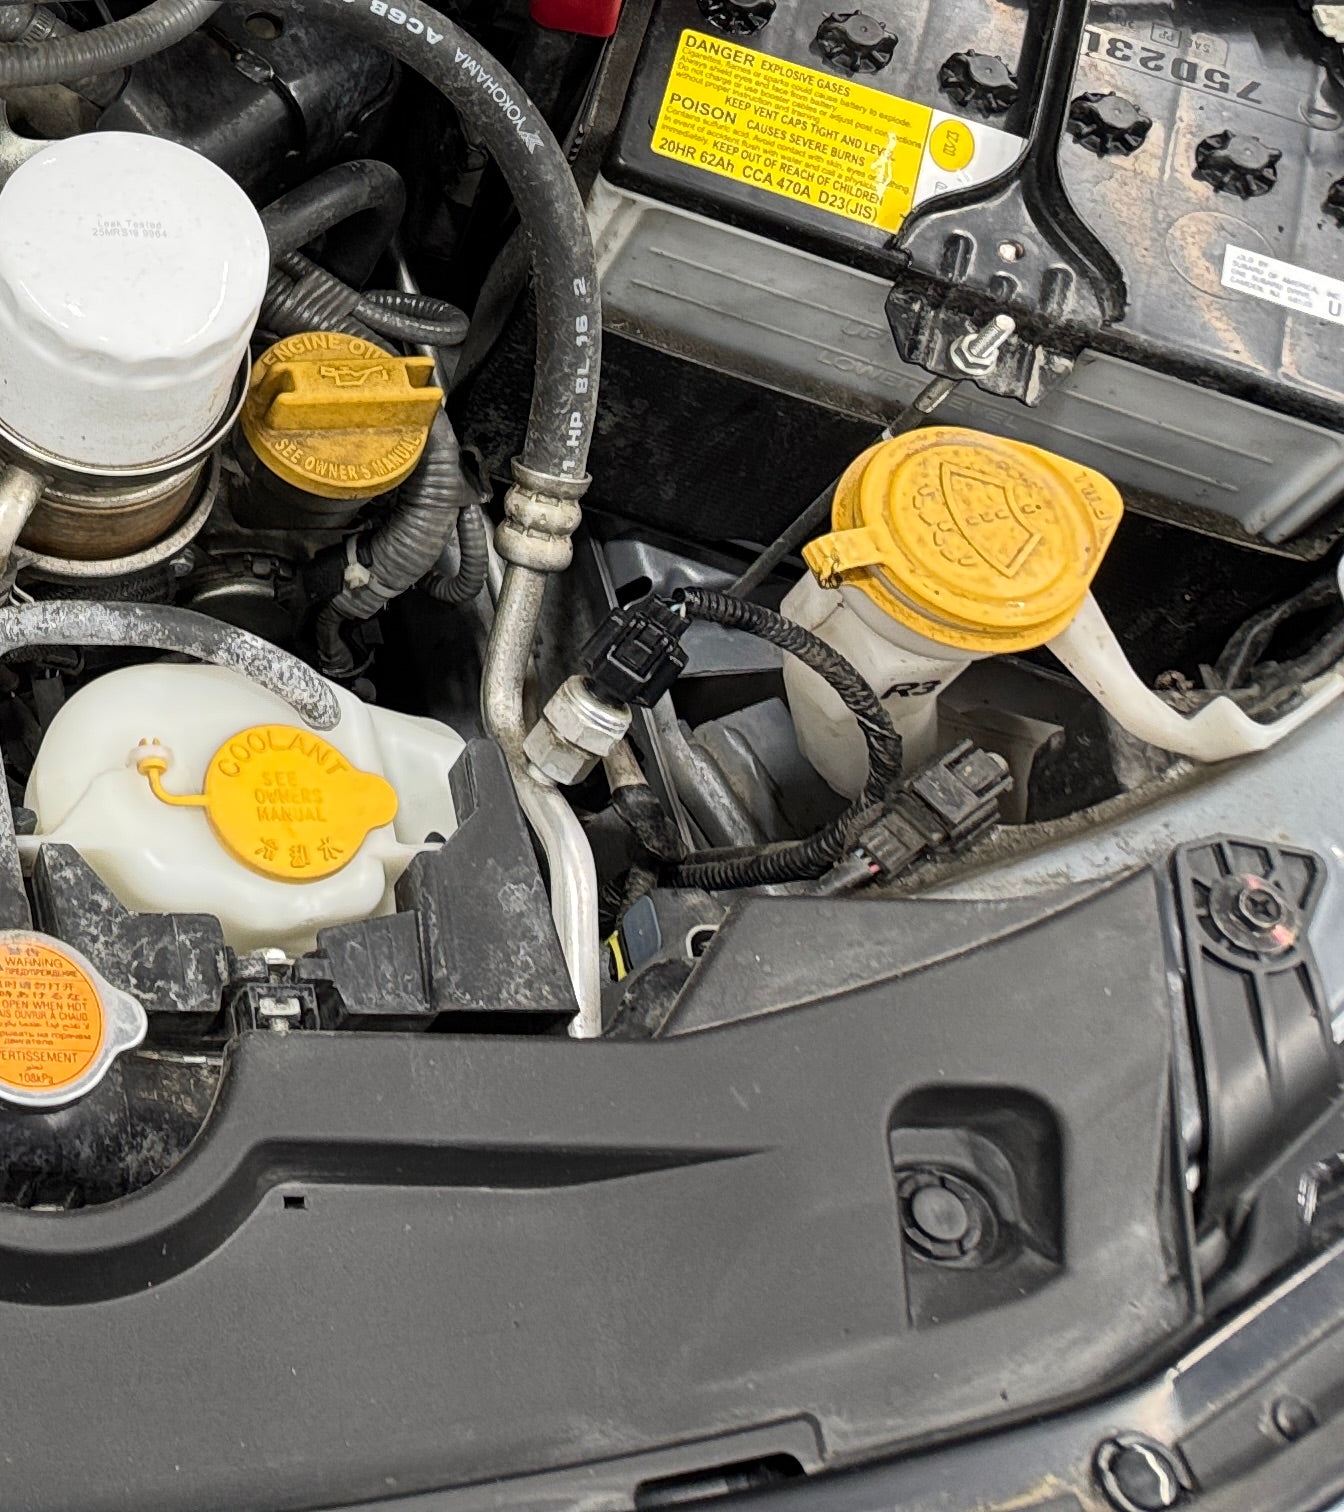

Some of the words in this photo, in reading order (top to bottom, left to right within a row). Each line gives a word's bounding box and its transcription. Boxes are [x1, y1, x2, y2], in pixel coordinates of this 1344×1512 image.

[683, 33, 756, 68] DANGER
[760, 59, 815, 85] EXPLOSIVE
[816, 78, 850, 97] GASES
[454, 47, 531, 132] YOKOHAMA
[667, 91, 738, 125] POISON
[746, 119, 787, 140] CAUSES
[789, 133, 829, 154] SEVERE
[830, 147, 866, 166] BURNS
[726, 96, 751, 110] KEEP
[754, 105, 779, 121] VENT
[781, 115, 807, 130] CAPS
[809, 123, 839, 141] TIGHT
[840, 134, 862, 149] AND
[658, 136, 697, 159] 20HR
[698, 150, 736, 172] 62Ah
[741, 164, 775, 185] CCA
[775, 176, 812, 198] 470A
[816, 189, 878, 222] D23(JIS)
[712, 139, 739, 156] KEEP
[740, 149, 761, 163] OUT
[762, 157, 777, 169] OF
[780, 162, 814, 182] REACH
[816, 174, 830, 187] OF
[831, 180, 883, 205] CHILDREN
[573, 276, 587, 296] 2
[576, 315, 589, 347] 16
[263, 334, 341, 366] ENGINE
[575, 358, 590, 394] BL
[566, 411, 582, 447] HP
[945, 393, 1019, 431] EVEL
[274, 438, 303, 464] SEE
[304, 456, 372, 481] OWNER'S
[372, 436, 421, 477] MANUAL
[880, 680, 942, 700] R3
[218, 730, 348, 778] COOLANT
[254, 788, 324, 805] OWNERS
[262, 771, 297, 786] SEE
[257, 806, 327, 822] MANUAL
[4, 957, 63, 969] WARNING
[2, 999, 29, 1009] OPEN
[33, 1000, 63, 1011] WHEN
[67, 1001, 88, 1011] HOT
[15, 1010, 47, 1020] OUVRIR
